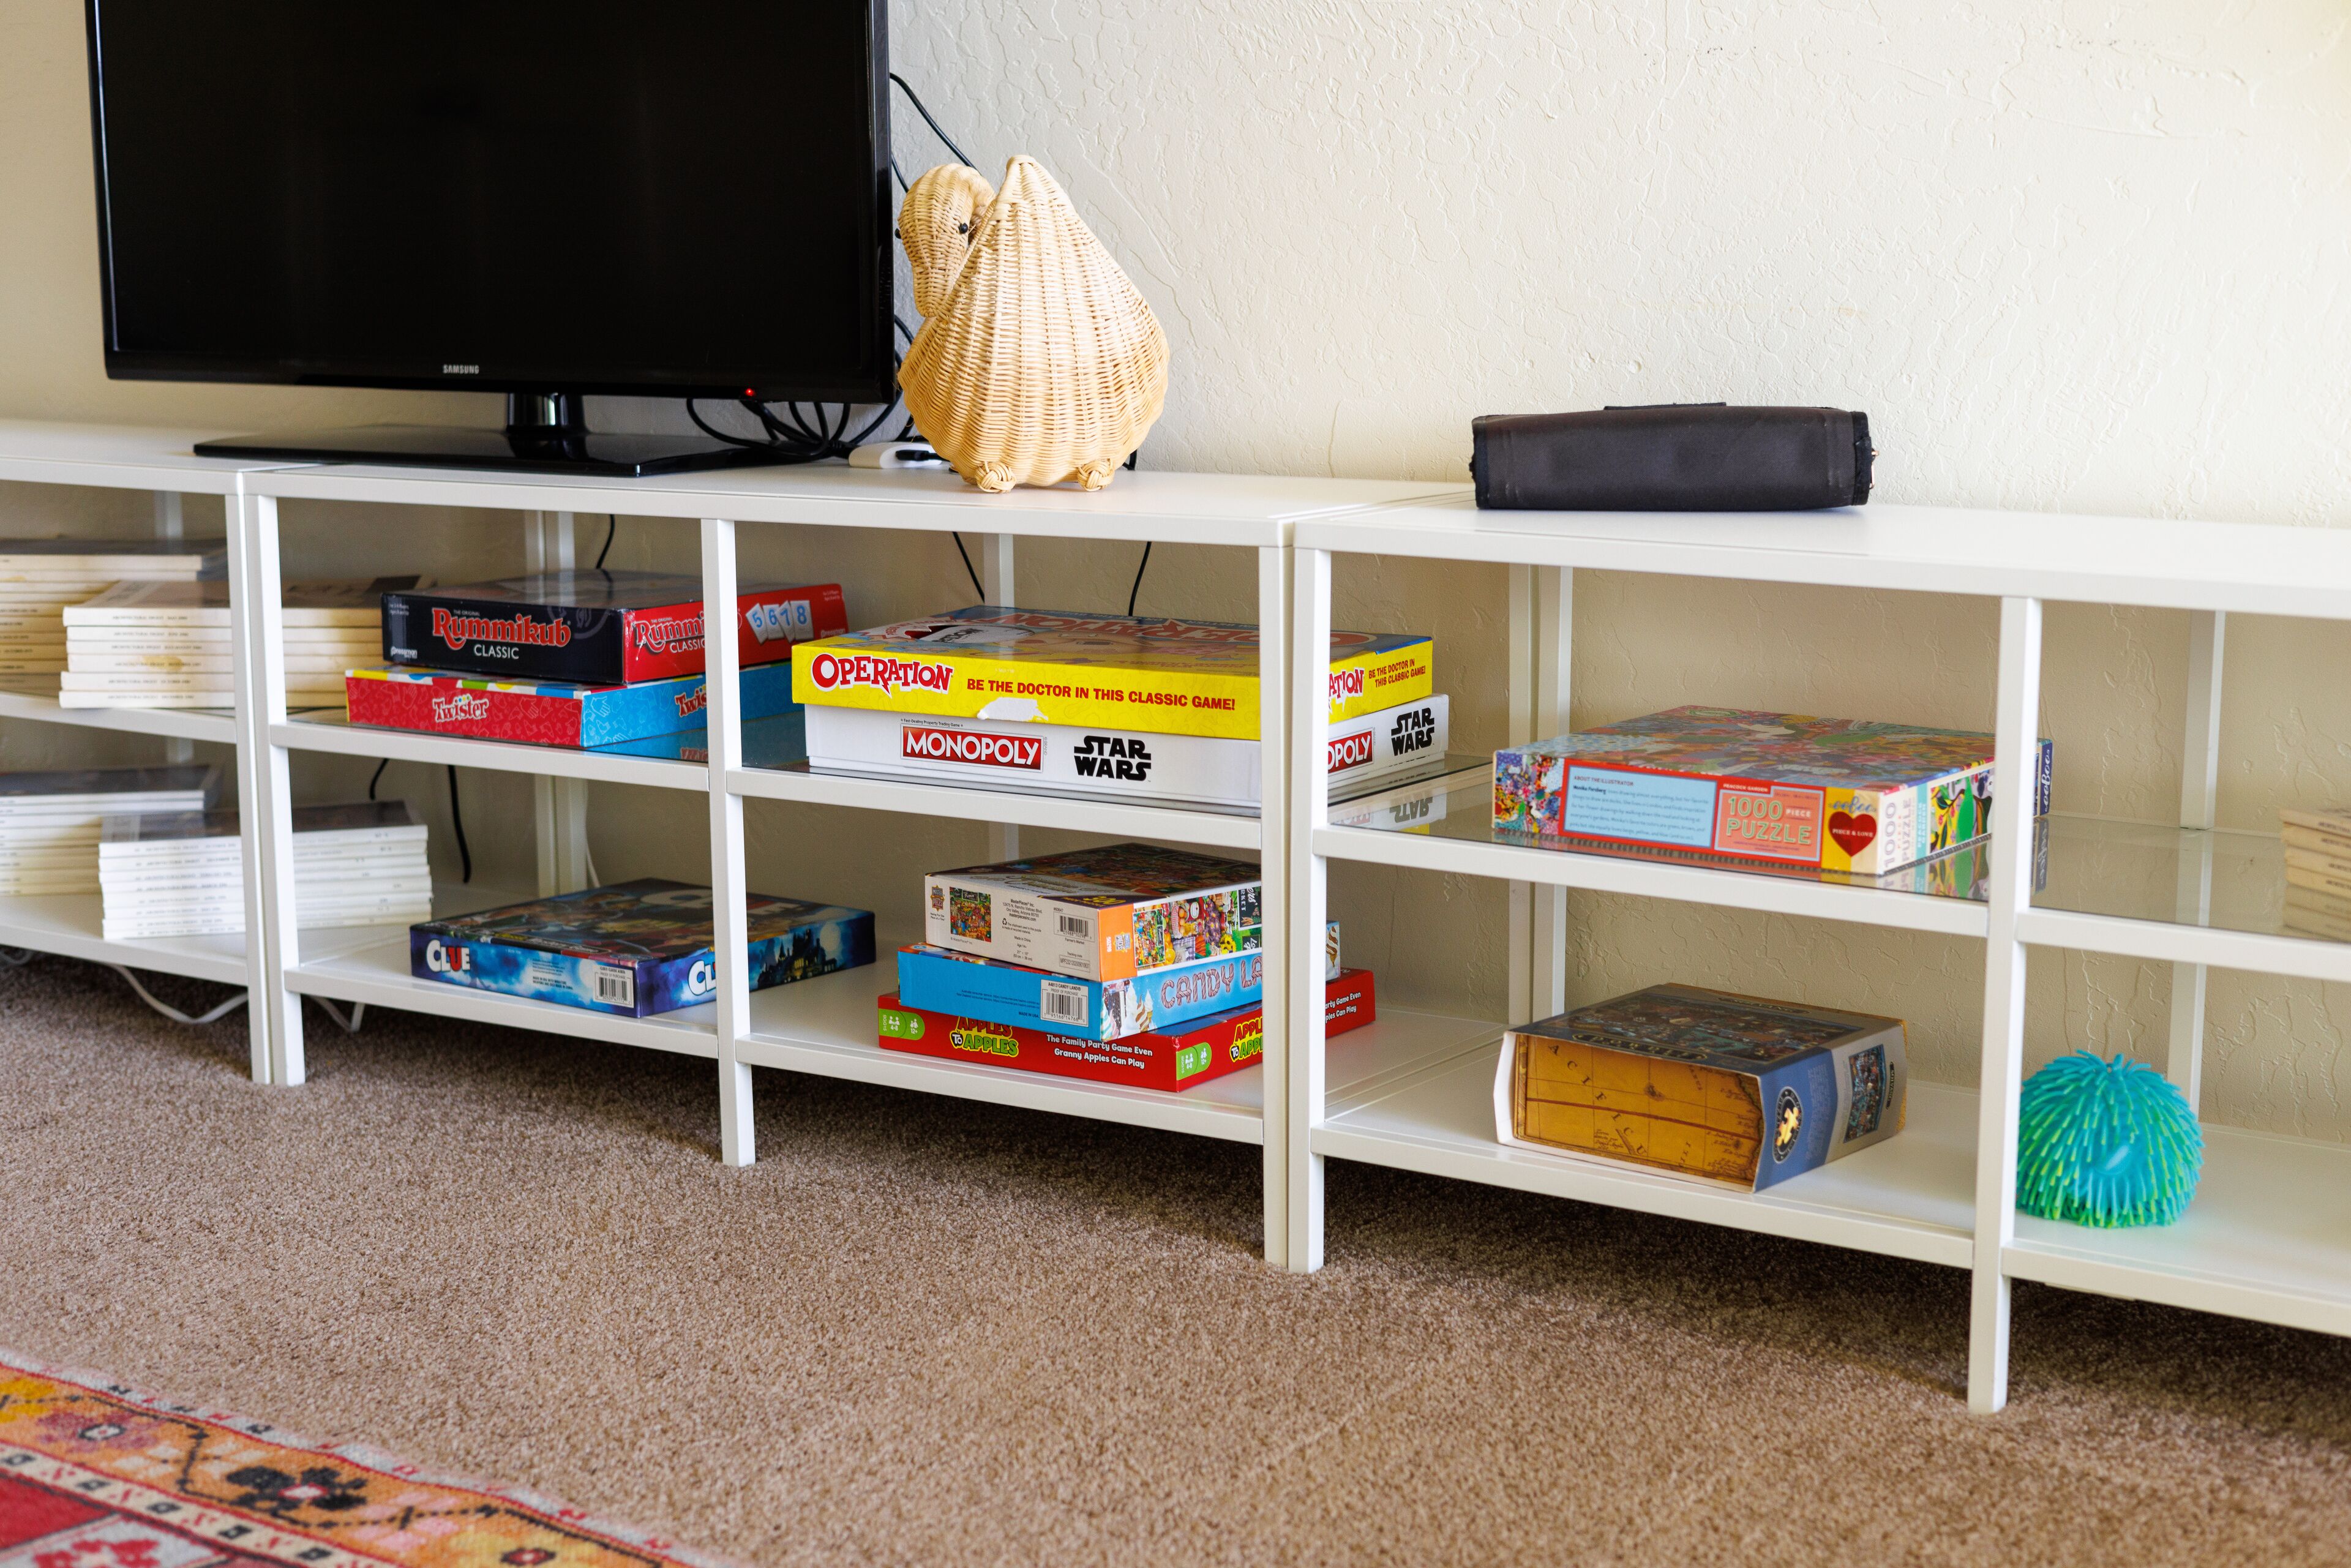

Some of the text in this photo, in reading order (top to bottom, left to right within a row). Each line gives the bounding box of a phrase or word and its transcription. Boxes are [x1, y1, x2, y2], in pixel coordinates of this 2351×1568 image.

[443, 364, 479, 375] SAMSUNG
[432, 607, 572, 651] Rummikub
[752, 604, 808, 628] 5 6 7 8
[473, 643, 520, 659] CLASSIC
[812, 653, 953, 697] OPERATION
[1369, 669, 1376, 679] BE
[1377, 666, 1387, 676] THE
[1388, 661, 1408, 673] DOCTOR
[1375, 666, 1426, 688] THIS CLASSIC GAME!
[967, 678, 1235, 711] BE THE DOCTOR IN THIS CLASSIC GAME!
[1329, 669, 1364, 700] ATION
[432, 696, 490, 723] Twister
[1391, 707, 1435, 737] STAR
[906, 730, 1040, 765] MONOPOLY
[1074, 735, 1152, 760] STAR
[1328, 734, 1371, 767] OPOLY
[1391, 727, 1435, 756] WARS
[1074, 756, 1152, 781] WARS
[1728, 796, 1783, 820] 1000
[1785, 808, 1812, 817] PIECE
[1726, 818, 1812, 845] PUZZLE
[1884, 803, 1896, 868] 1000
[427, 939, 470, 972] CLUE
[688, 959, 716, 996] CL
[1161, 956, 1262, 1009] CANDY LA
[1325, 991, 1361, 1009] arty Game Even
[1336, 1008, 1346, 1017] Can
[1346, 1005, 1357, 1015] Play
[964, 1036, 1019, 1057] APPLES
[1046, 1035, 1153, 1057] The Family Party Game Even
[1054, 1048, 1145, 1070] Granny Apples Can Play
